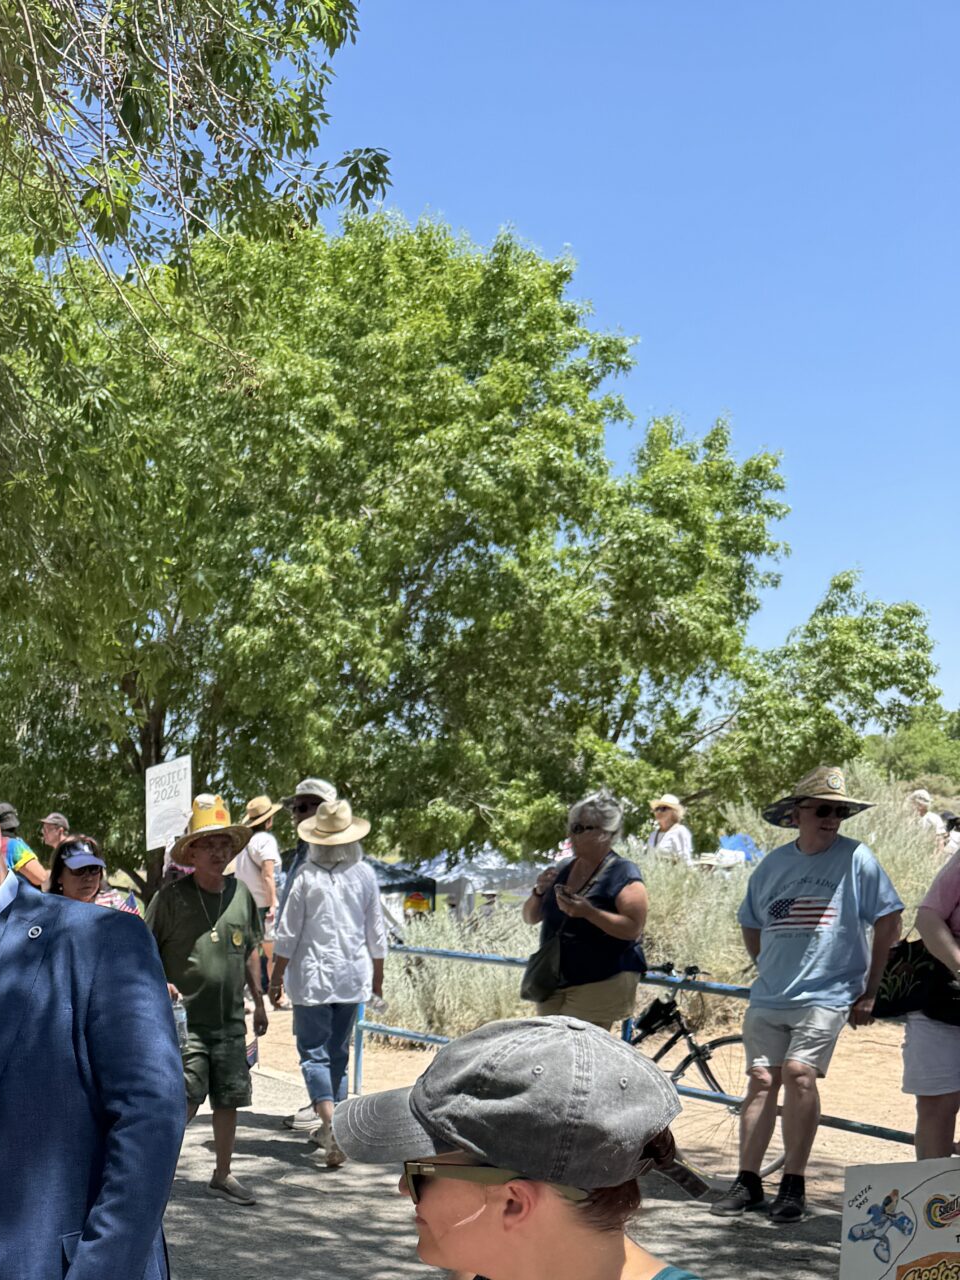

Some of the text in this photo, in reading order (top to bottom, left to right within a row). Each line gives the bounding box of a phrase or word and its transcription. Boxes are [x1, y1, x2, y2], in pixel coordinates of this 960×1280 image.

[149, 768, 188, 791] PROJECT
[154, 785, 180, 803] 2026
[847, 1184, 872, 1208] CHESTER
